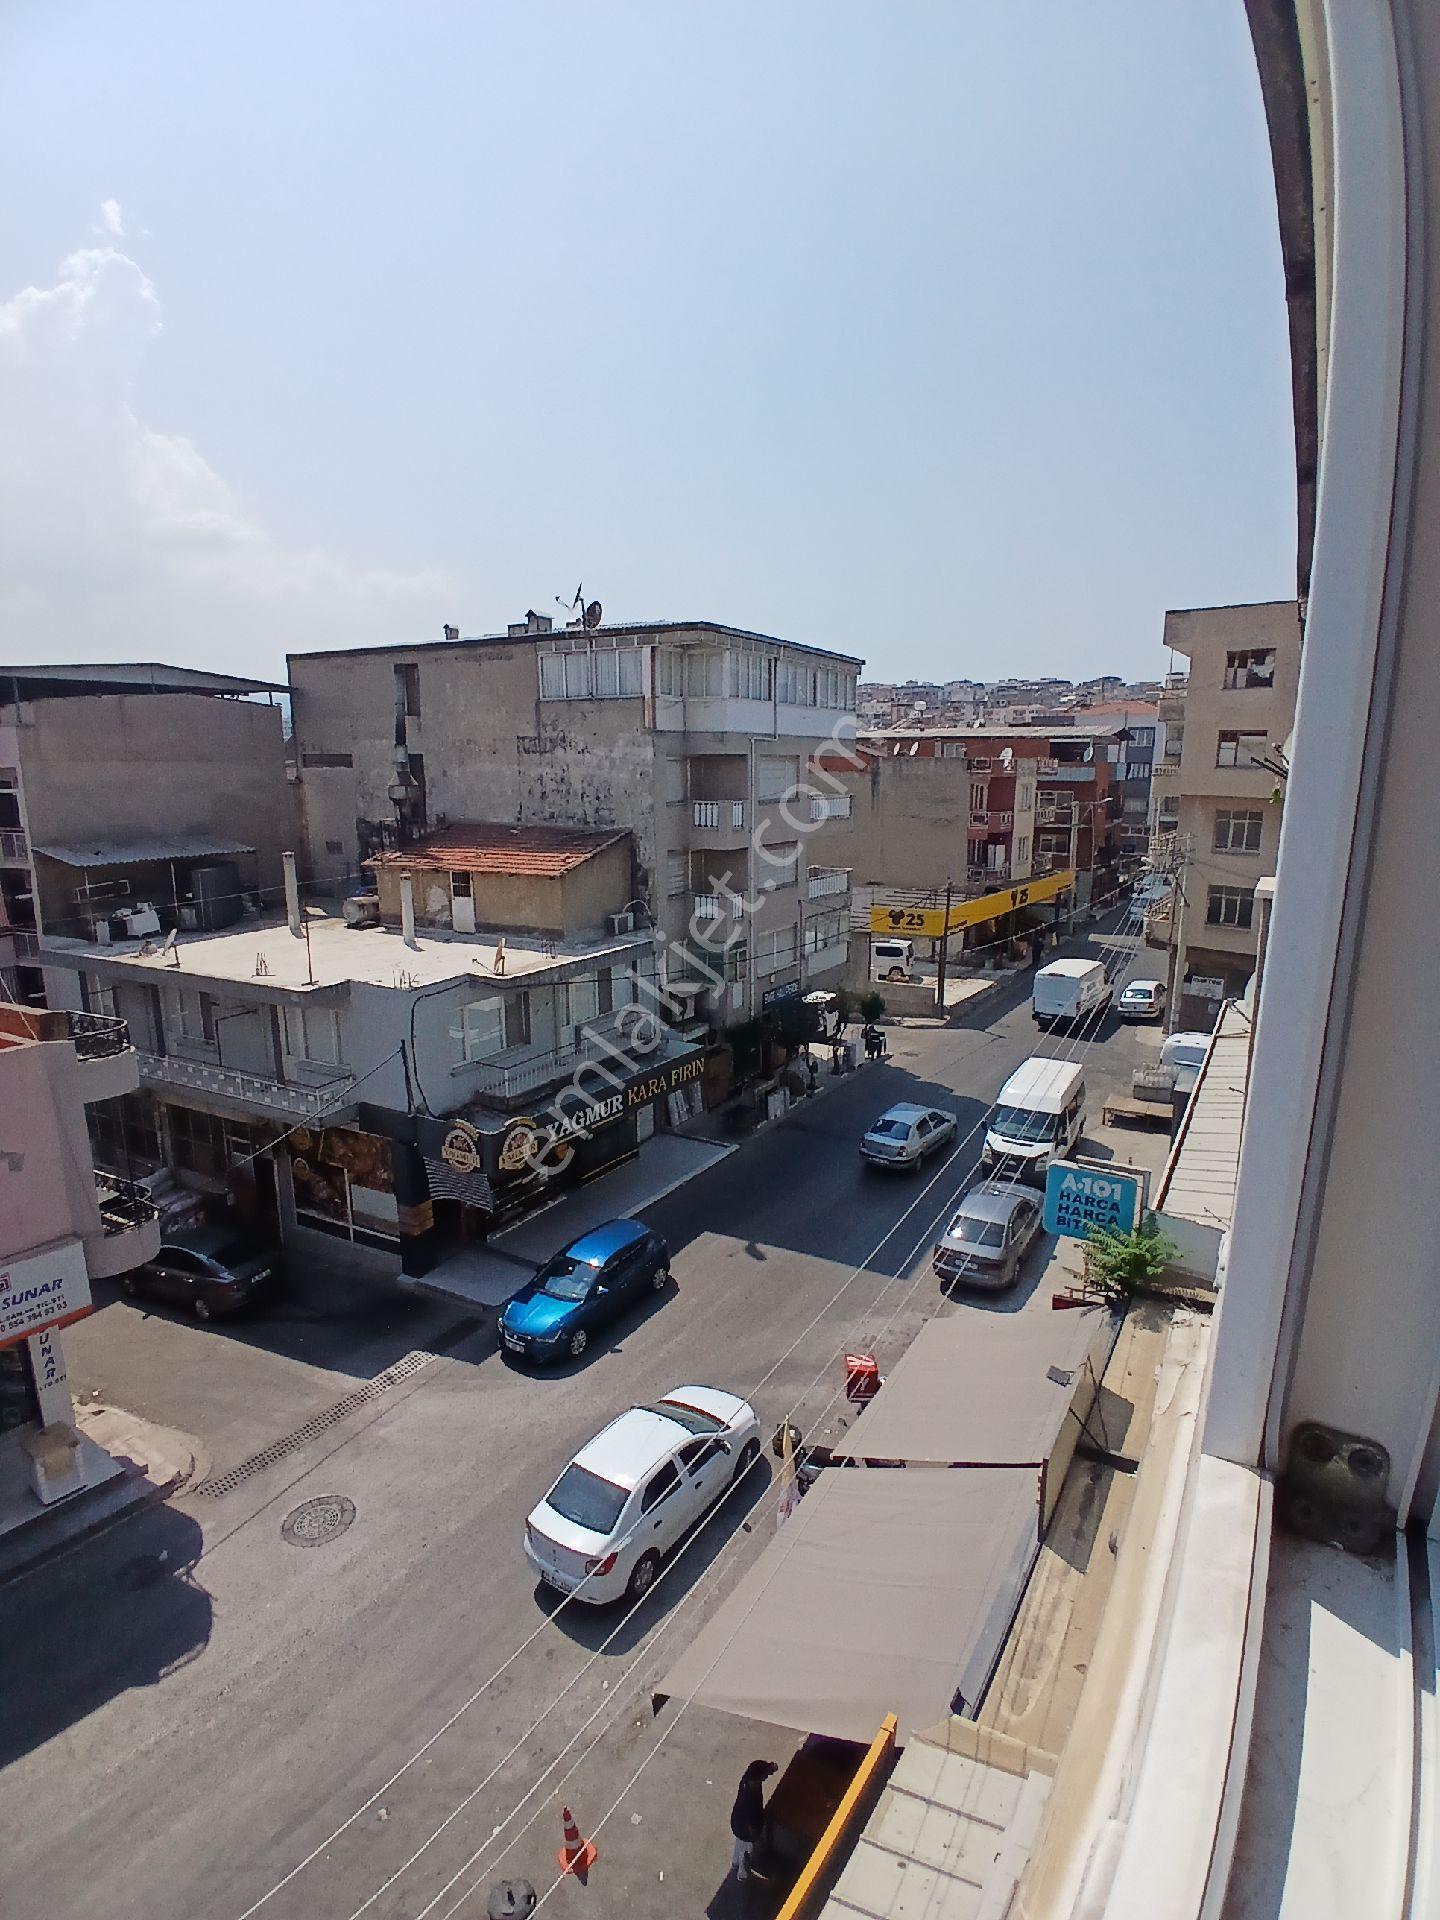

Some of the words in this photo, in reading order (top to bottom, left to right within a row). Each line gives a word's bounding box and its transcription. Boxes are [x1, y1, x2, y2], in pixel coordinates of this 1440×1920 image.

[906, 913, 925, 926] 25
[628, 1075, 667, 1106] KARA
[671, 1057, 705, 1086] FIRIN
[1060, 1190, 1121, 1213] HARCA
[1058, 1202, 1119, 1226] HARCA
[2, 1278, 63, 1310] SUNAR
